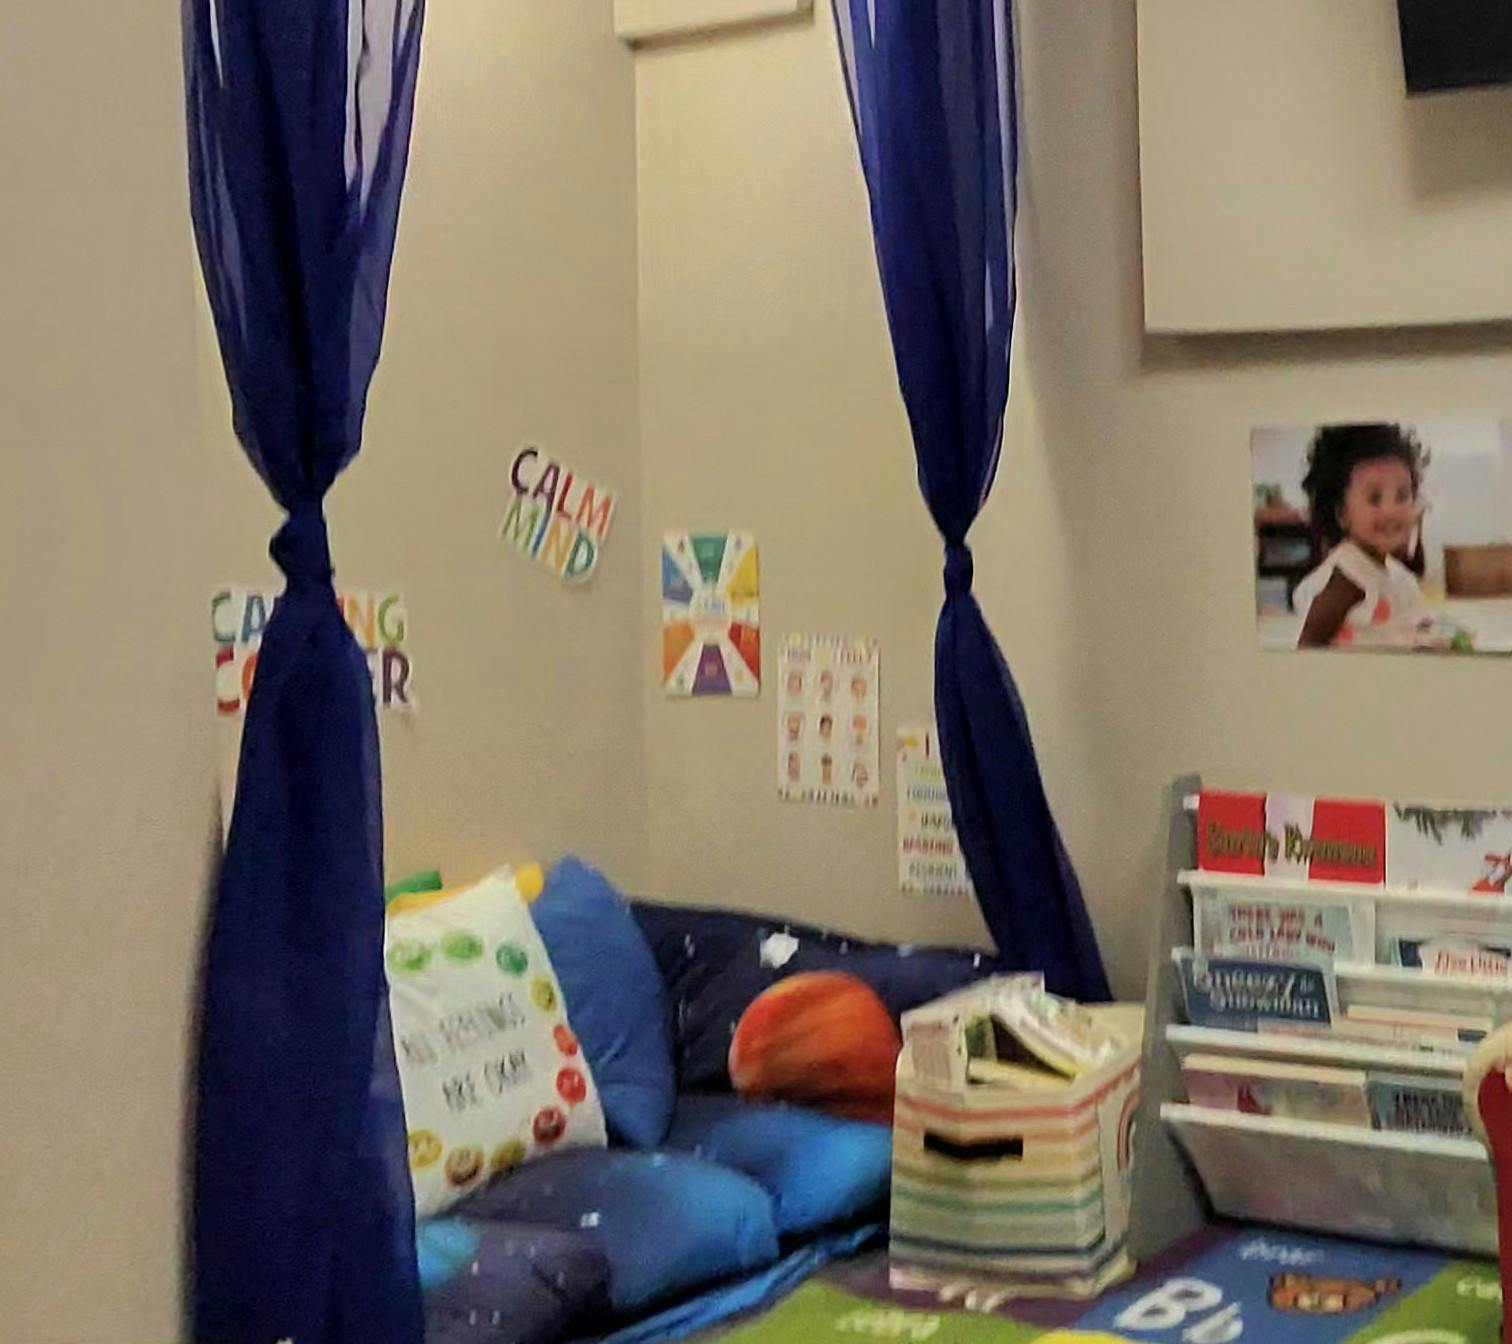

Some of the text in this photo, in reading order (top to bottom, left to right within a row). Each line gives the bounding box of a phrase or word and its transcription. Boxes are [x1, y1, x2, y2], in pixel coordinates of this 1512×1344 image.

[511, 447, 612, 536] CALM
[502, 498, 599, 580] MIND
[211, 591, 406, 646] CANG
